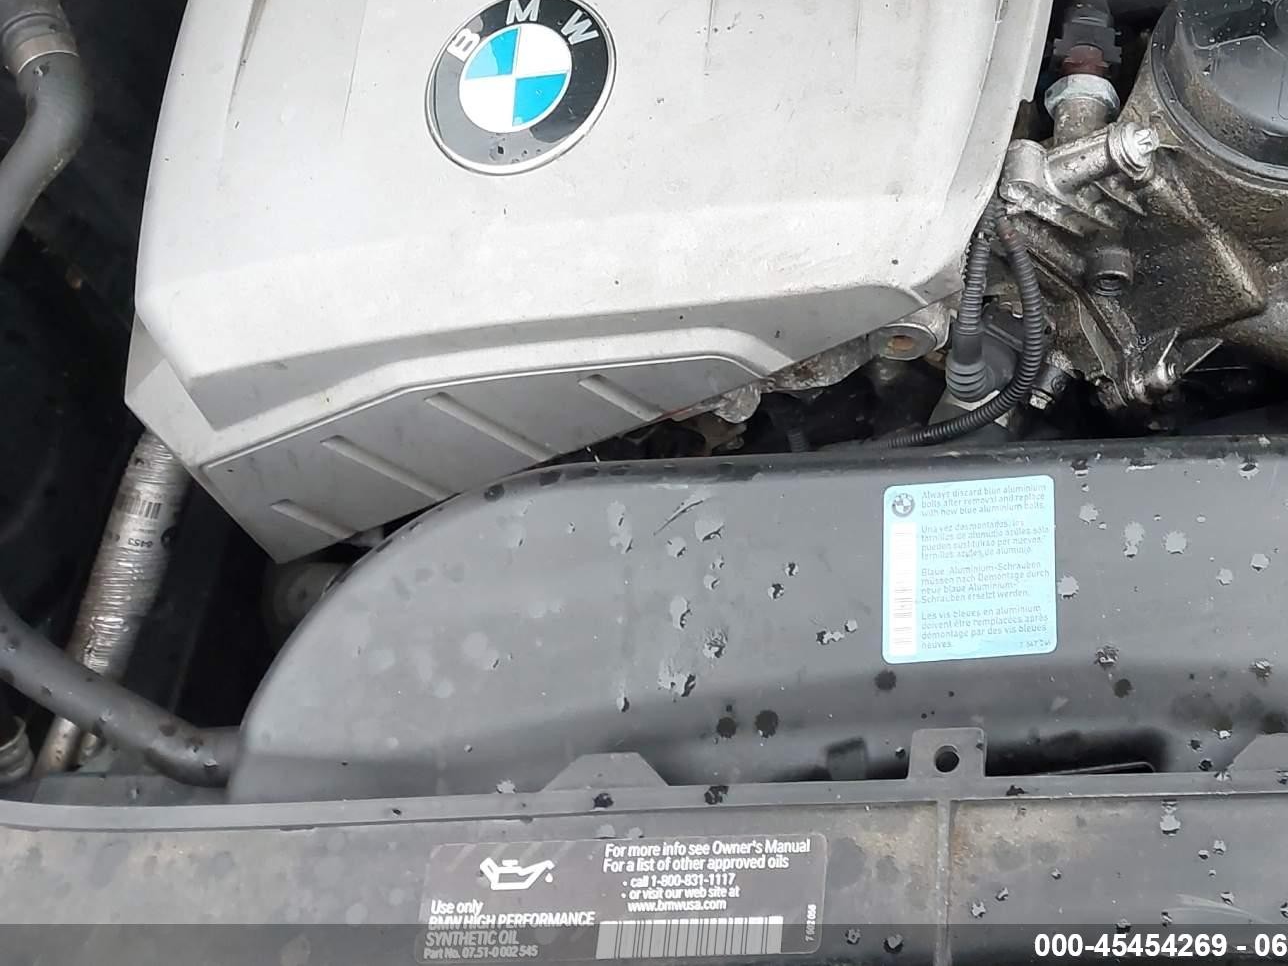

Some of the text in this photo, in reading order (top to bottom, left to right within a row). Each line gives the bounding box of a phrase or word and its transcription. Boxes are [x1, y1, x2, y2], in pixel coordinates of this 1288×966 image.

[604, 838, 811, 858] For more info see Owner's Manual
[603, 854, 790, 872] For a list of other approved oils
[630, 872, 736, 888] call 1-800-831-1117
[628, 886, 741, 900] or visit our web site at
[430, 898, 484, 916] Use only
[627, 899, 727, 912] www.bmwusa.com
[428, 911, 596, 930] BMW HIGH PERFORMANCE
[425, 930, 520, 947] SYNTHETIC OIL
[423, 948, 444, 960] Part
